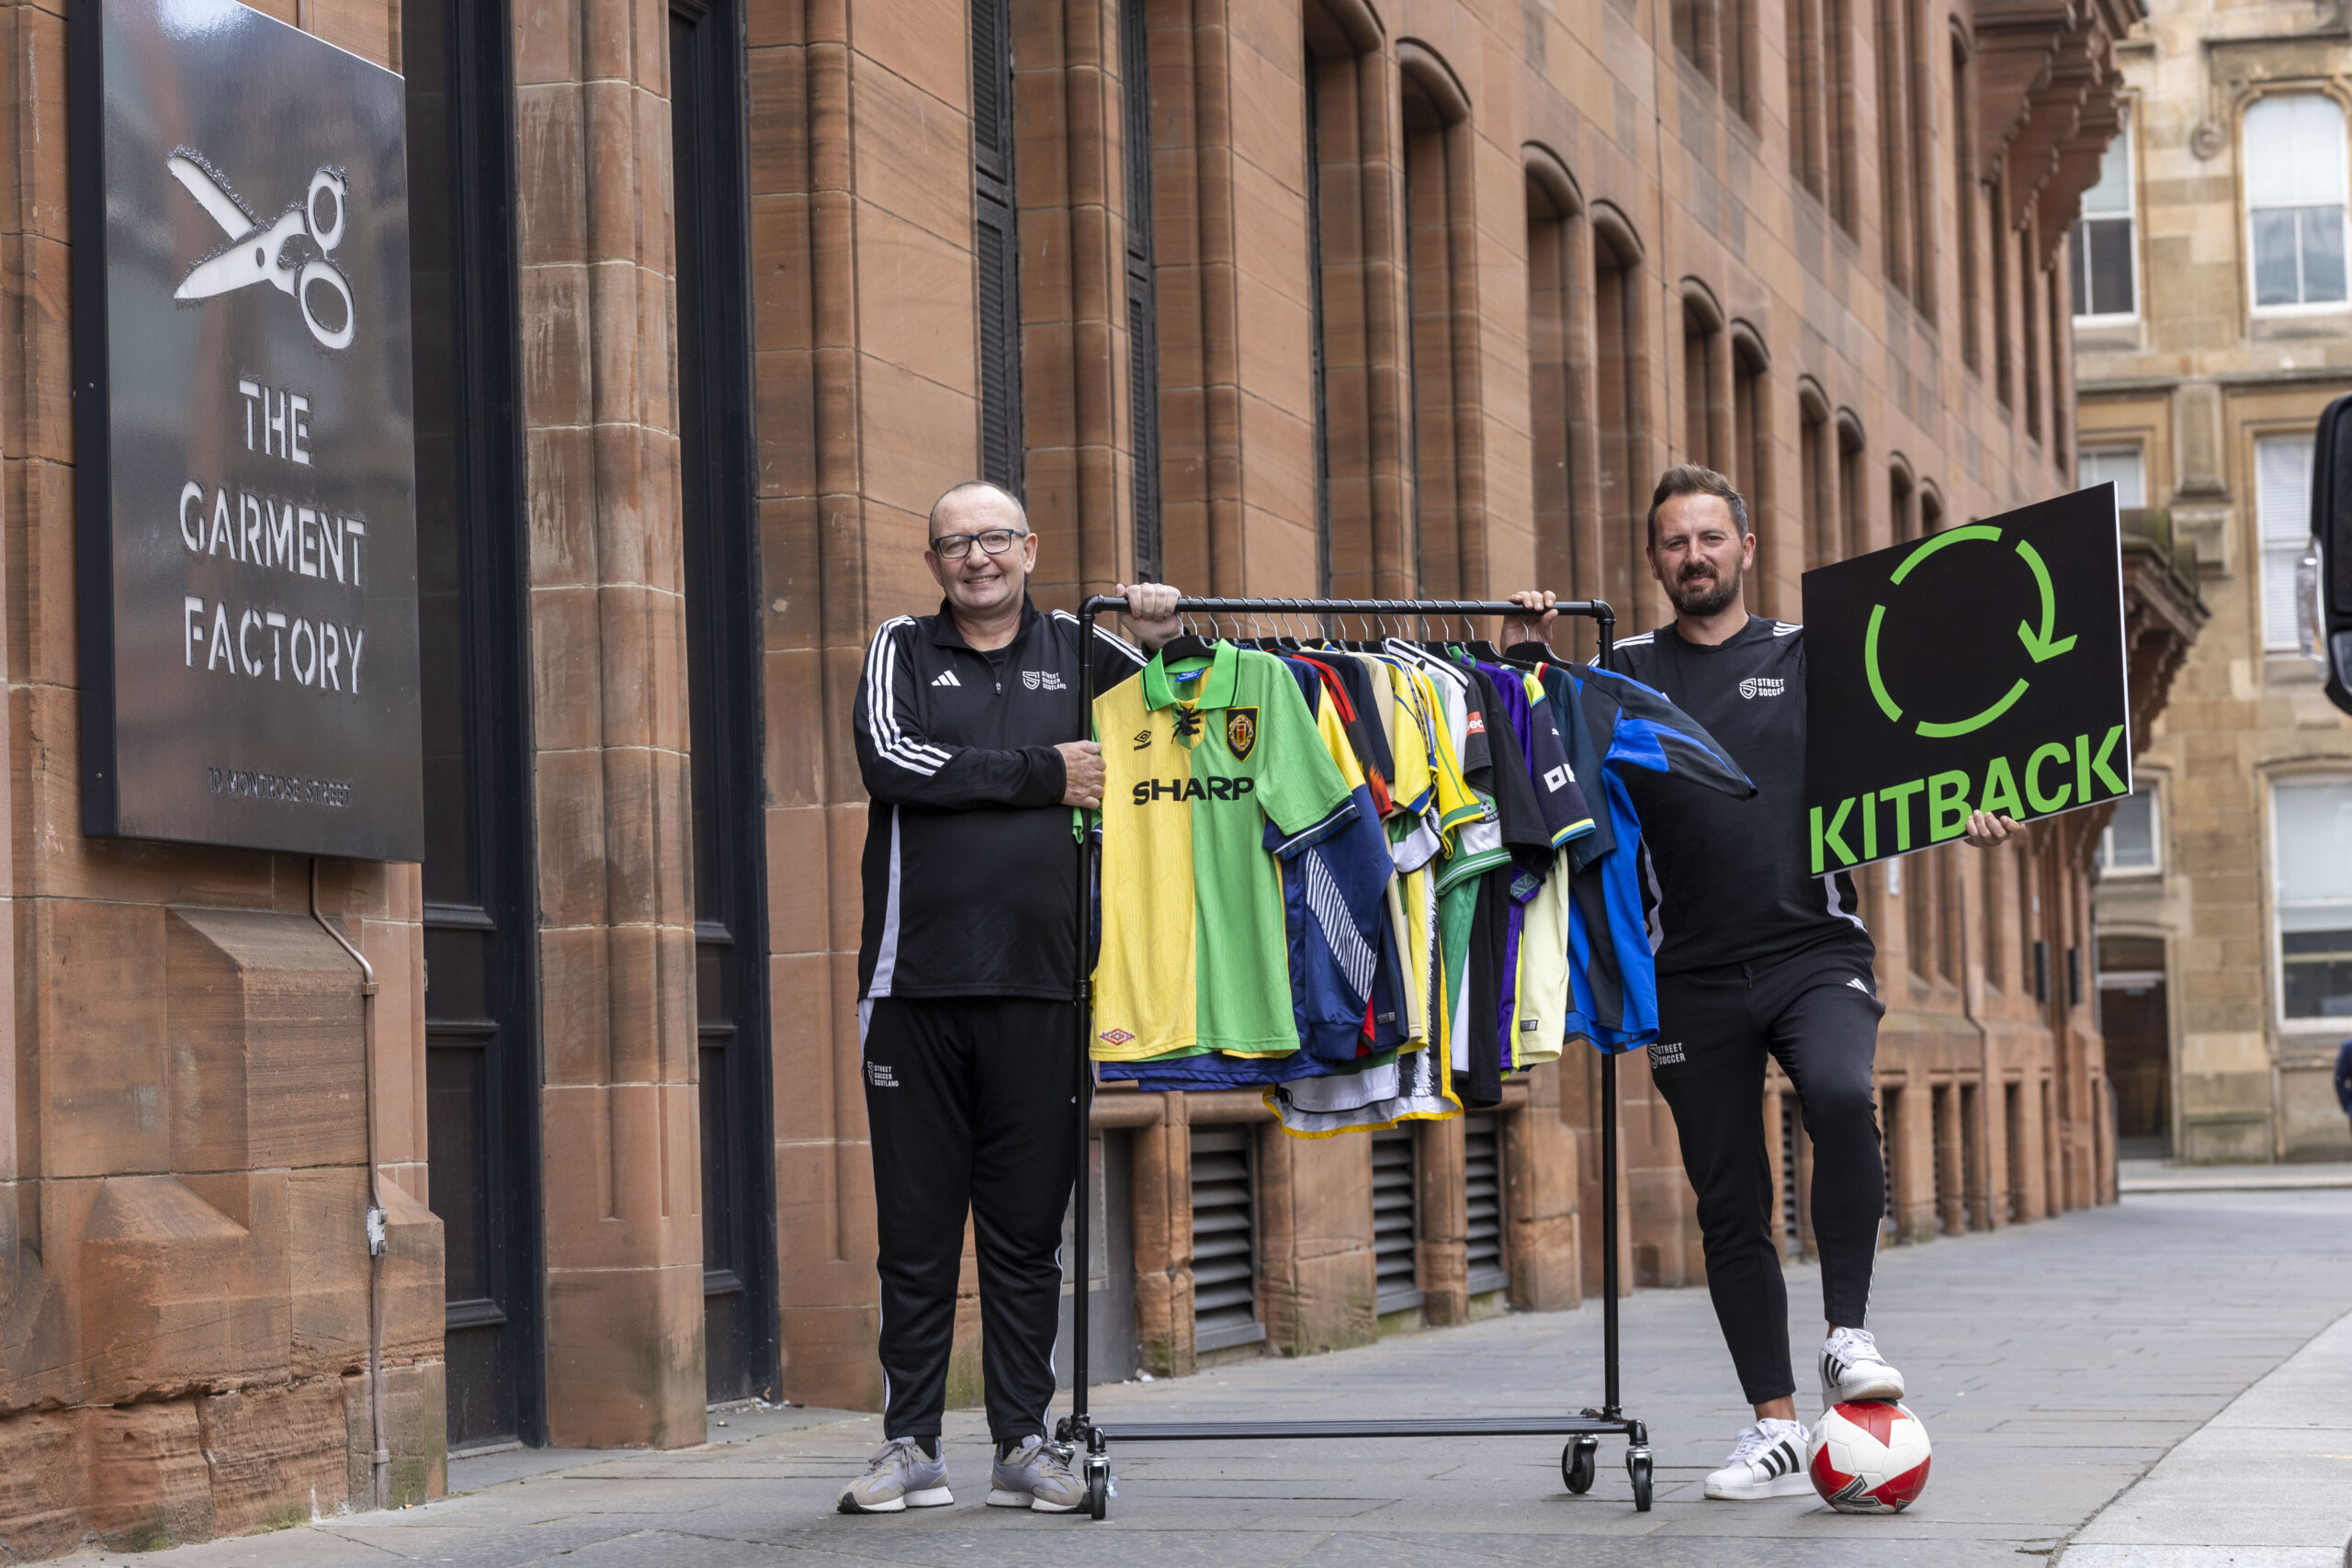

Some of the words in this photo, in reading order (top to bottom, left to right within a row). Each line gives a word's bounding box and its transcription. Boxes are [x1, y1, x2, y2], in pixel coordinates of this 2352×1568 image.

[239, 379, 311, 465] THE
[179, 479, 366, 586] GARMENT
[185, 595, 365, 694] FACTORY
[1041, 671, 1059, 680] STREET
[1042, 676, 1061, 685] SOCCER
[1042, 682, 1067, 691] SCOTLAND
[1757, 677, 1785, 687] STREET
[1758, 685, 1785, 697] SOCCER
[208, 766, 222, 793] 10
[227, 769, 301, 802] MONTROSE
[306, 778, 352, 807] STREET
[1132, 775, 1255, 806] SHARP
[1809, 724, 2128, 874] KITBACK
[1657, 1042, 1683, 1055] STREET
[1658, 1053, 1687, 1066] SOCCER
[874, 1065, 892, 1073] STREET
[874, 1072, 893, 1080] SOCCER
[874, 1078, 899, 1088] SCOTLAND
